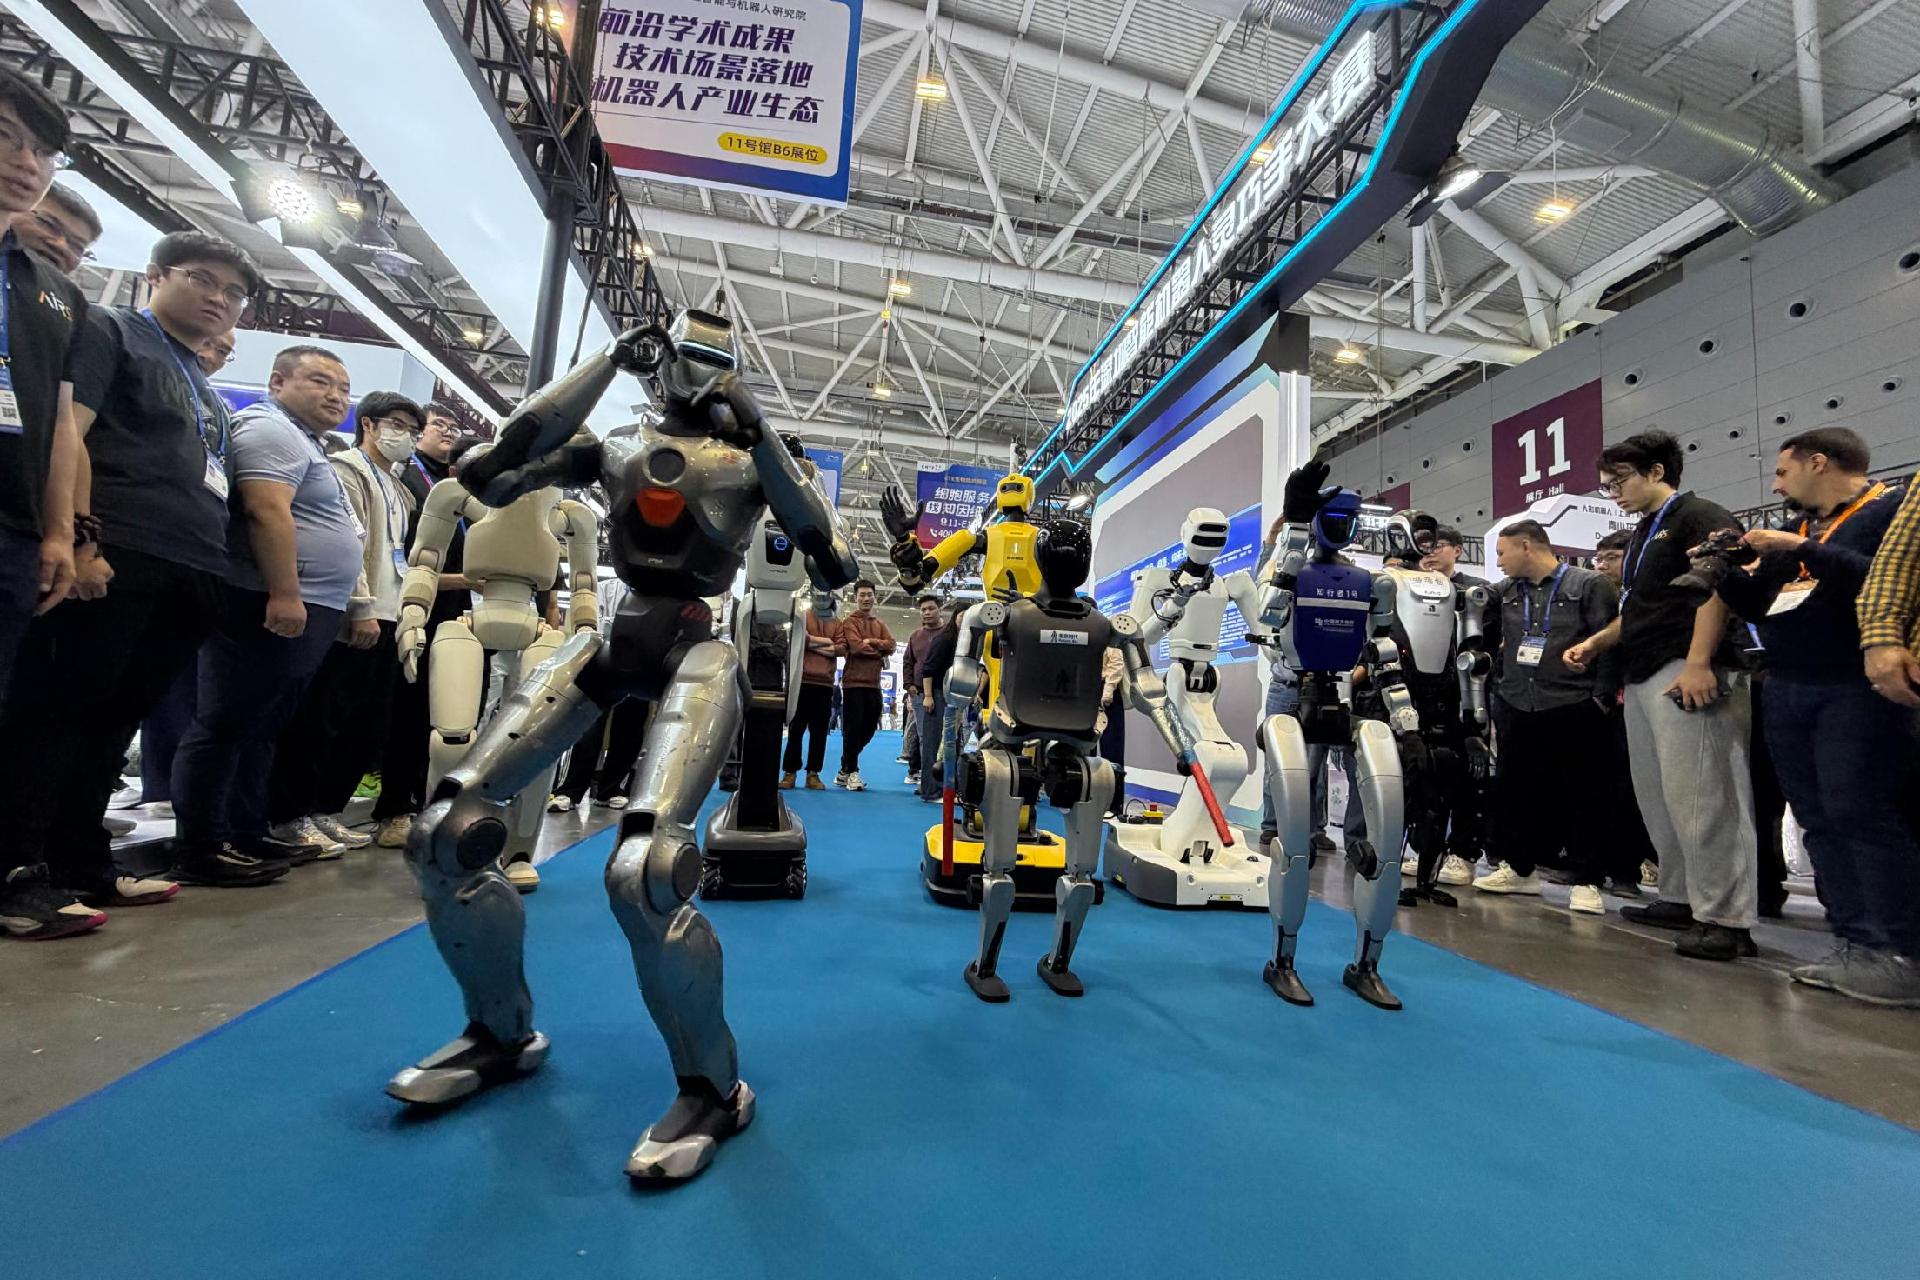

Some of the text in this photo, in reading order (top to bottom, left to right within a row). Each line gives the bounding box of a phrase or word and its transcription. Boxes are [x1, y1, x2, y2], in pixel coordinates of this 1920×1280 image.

[597, 8, 796, 54] 前沿学术成果
[613, 42, 814, 89] 技术场景落地
[590, 74, 825, 124] 机器人产业生态
[727, 136, 819, 162] 11号馆B6展位
[1517, 416, 1571, 486] 11
[934, 487, 991, 504] 细胞服务
[1525, 483, 1565, 503] 展厅 Hall
